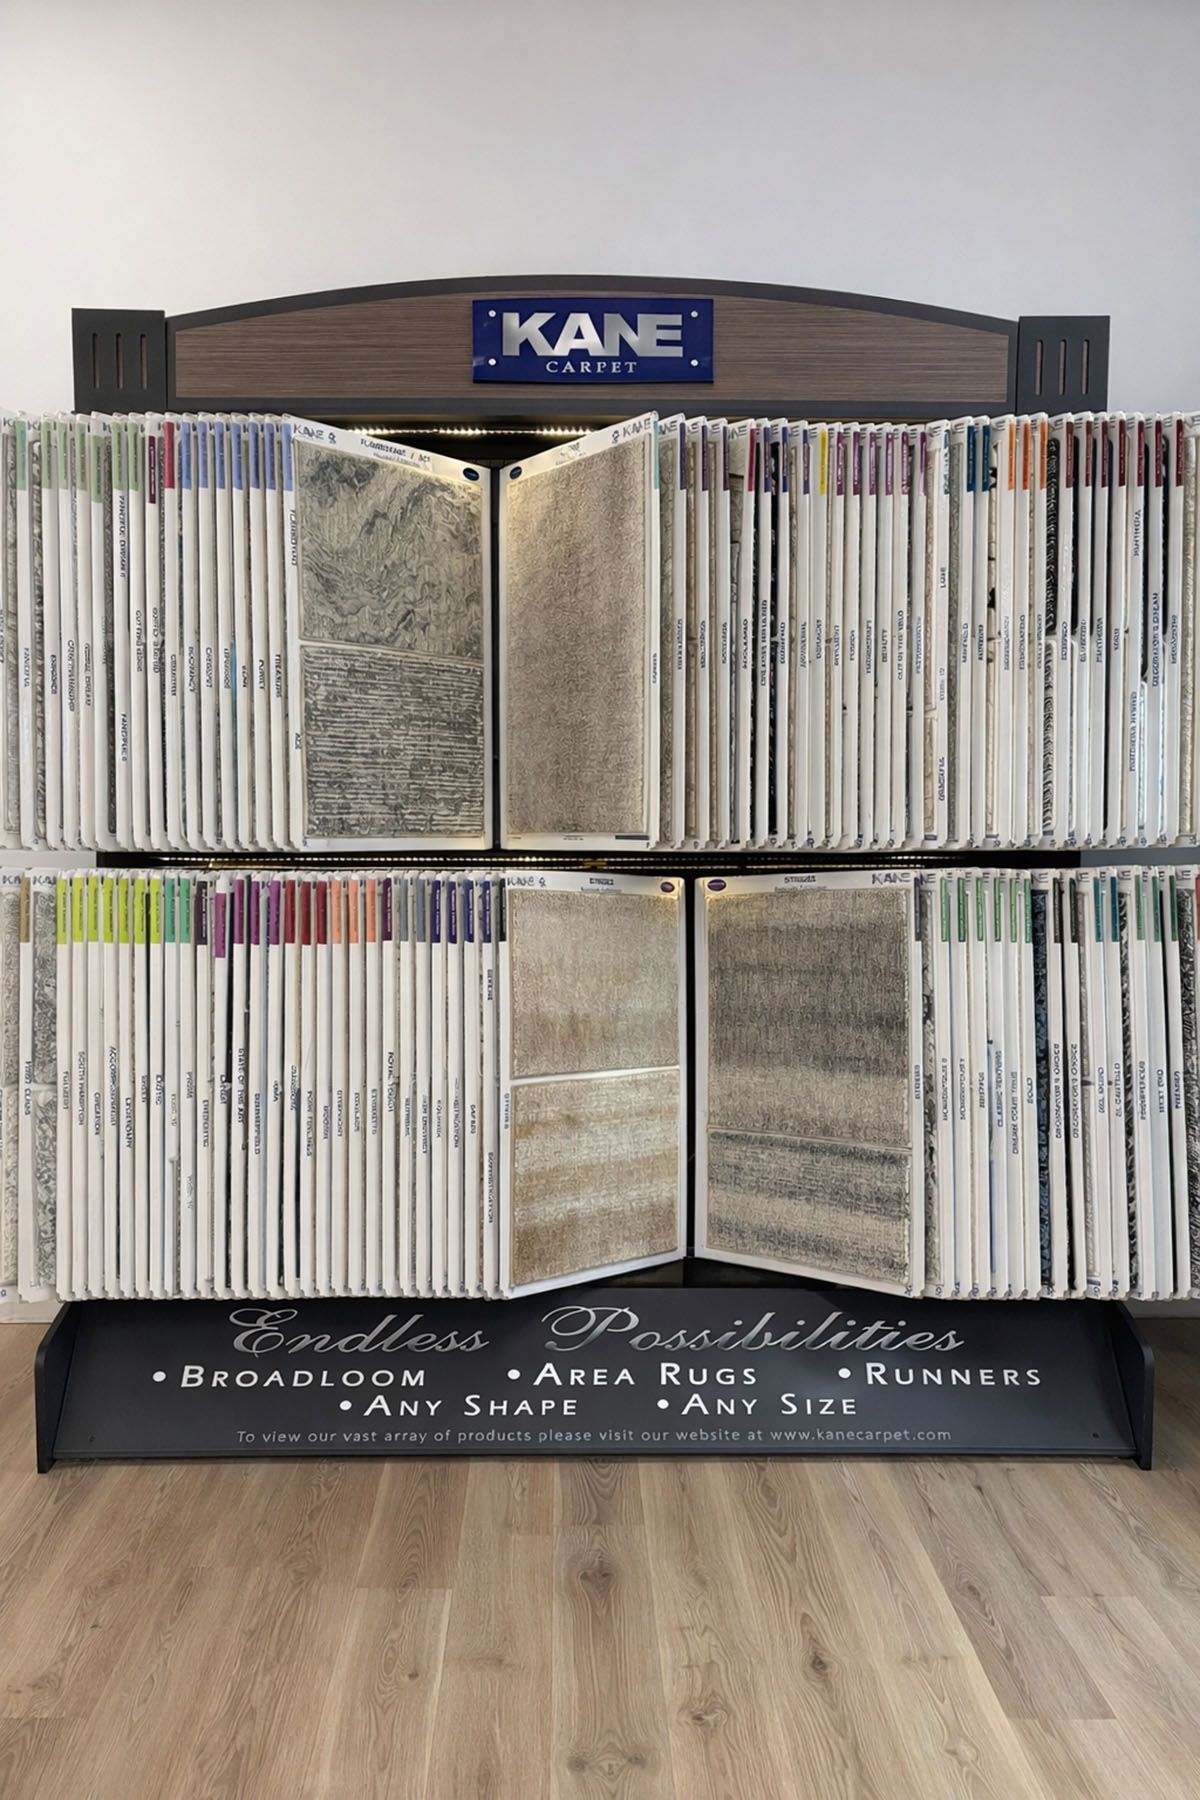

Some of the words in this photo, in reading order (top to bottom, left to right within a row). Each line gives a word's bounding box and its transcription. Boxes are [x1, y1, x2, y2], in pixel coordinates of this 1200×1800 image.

[502, 312, 682, 357] KANE
[546, 361, 637, 373] CARPET
[229, 1307, 490, 1358] Endless
[541, 1306, 965, 1352] Possibilities
[180, 1365, 425, 1388] BROADLOOM
[532, 1362, 635, 1386] AREA
[660, 1362, 757, 1386] RUGS
[865, 1362, 1041, 1386] RUNNERS
[363, 1394, 442, 1417] ANY
[463, 1394, 577, 1417] SHAPE
[681, 1393, 758, 1416] ANY
[780, 1392, 857, 1415] SIZE
[236, 1430, 256, 1443] To
[262, 1430, 301, 1443] view
[307, 1433, 337, 1443] our
[342, 1431, 377, 1442] vast
[384, 1432, 428, 1445] array
[433, 1429, 451, 1442] of
[457, 1429, 532, 1445] products
[538, 1429, 592, 1445] please
[599, 1429, 634, 1442] visit
[640, 1431, 670, 1442] our
[675, 1428, 741, 1442] website
[747, 1428, 763, 1442] at
[769, 1426, 952, 1446] www.kanecarpet.com
